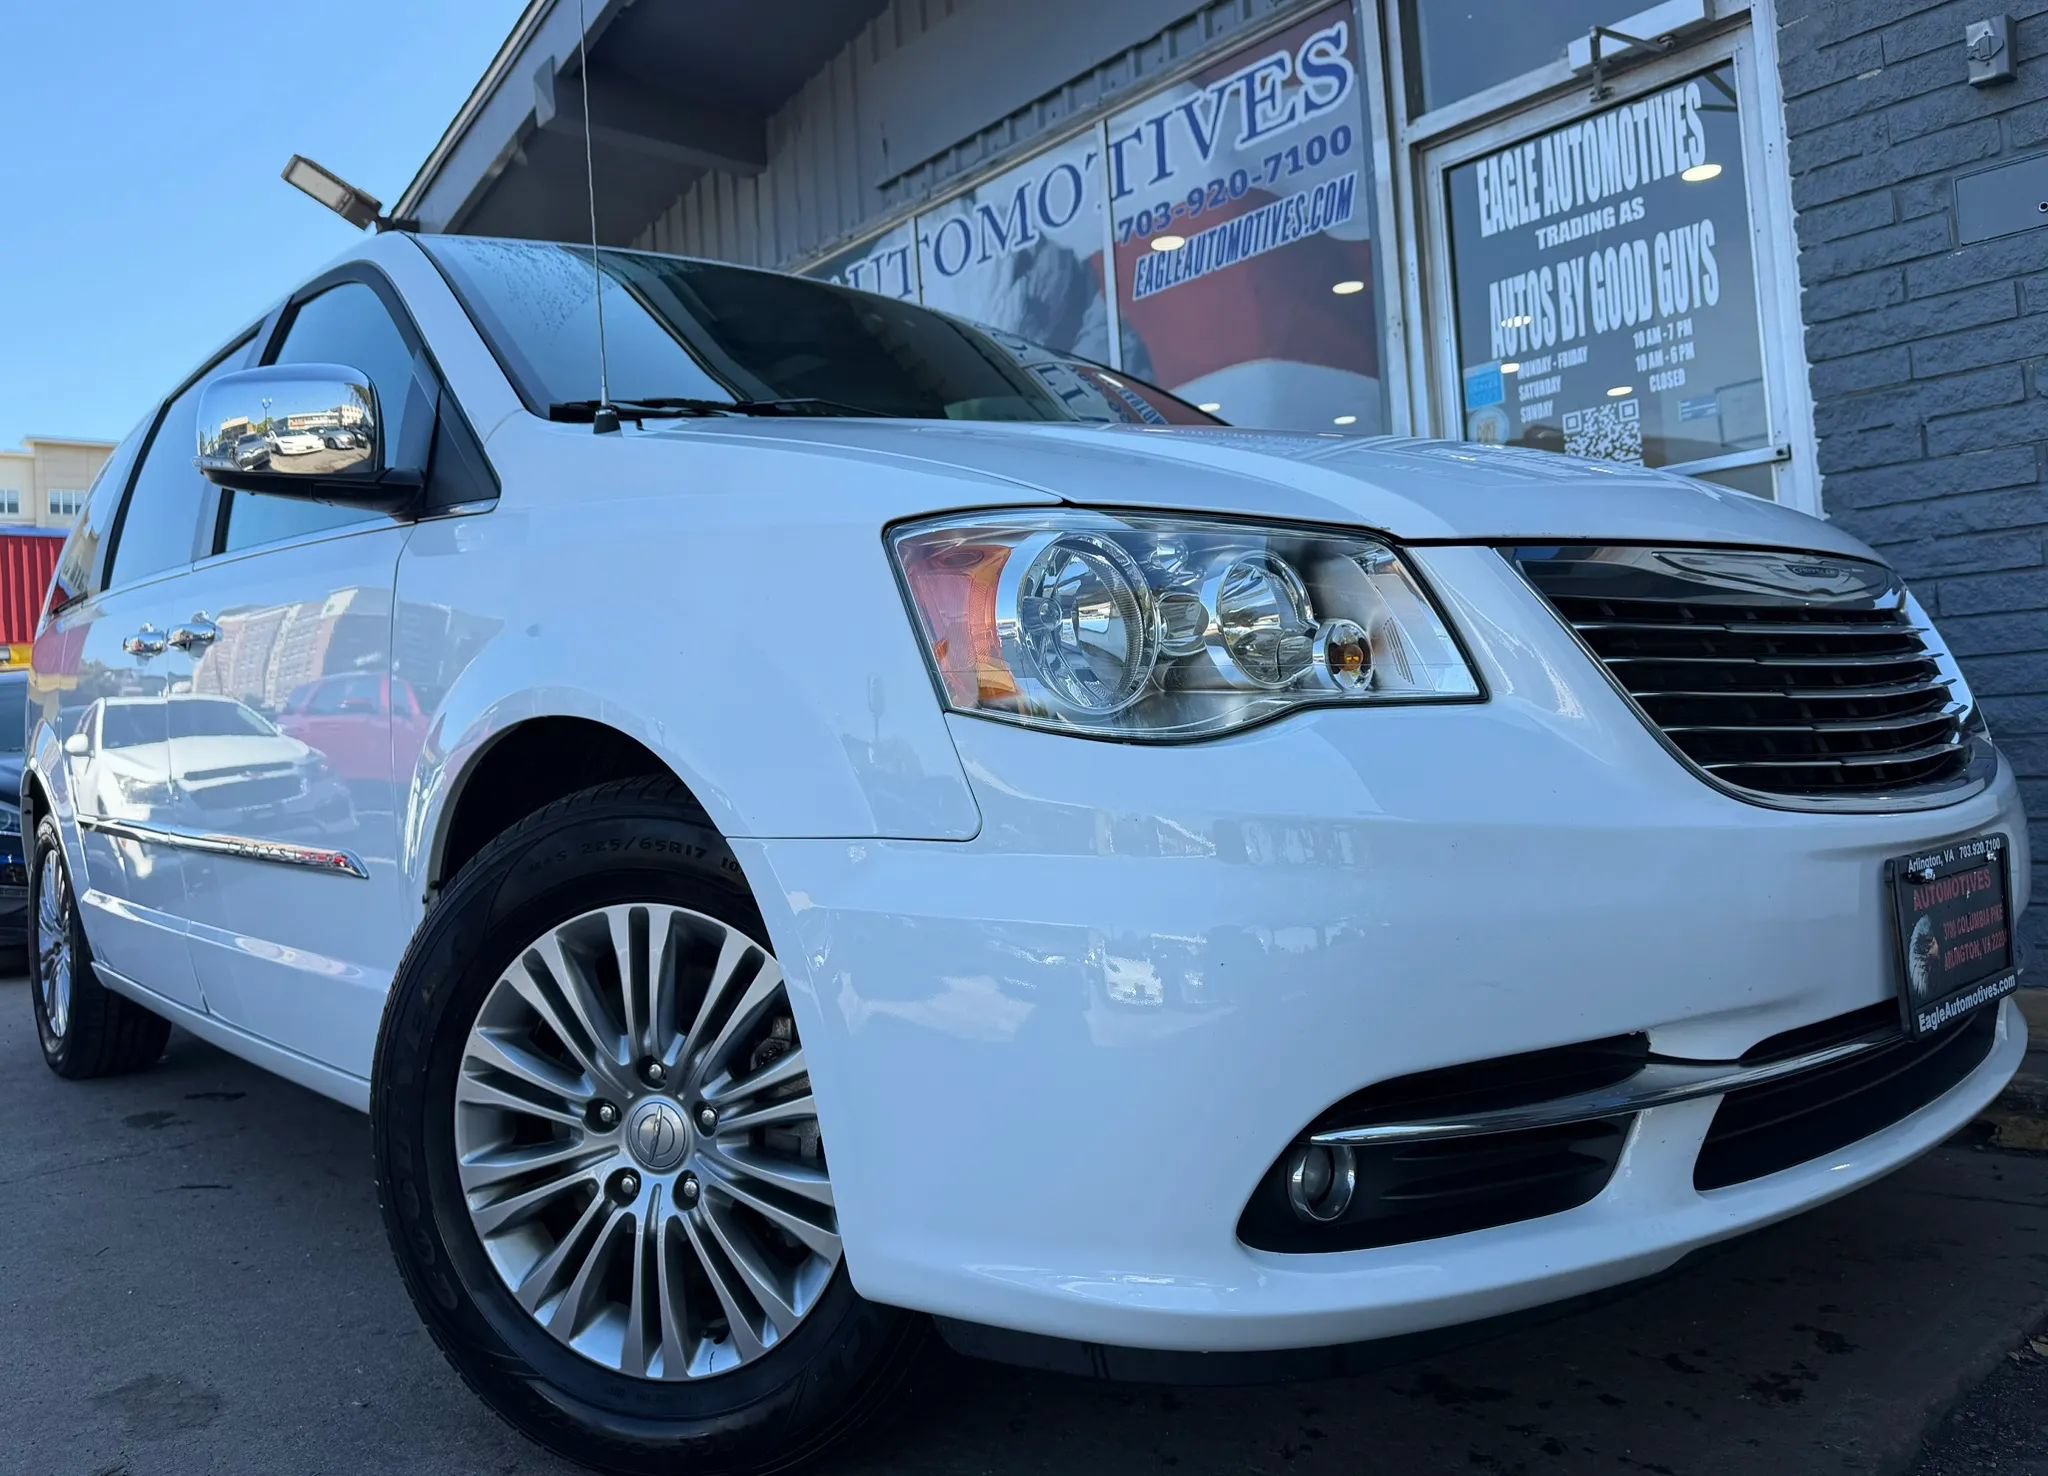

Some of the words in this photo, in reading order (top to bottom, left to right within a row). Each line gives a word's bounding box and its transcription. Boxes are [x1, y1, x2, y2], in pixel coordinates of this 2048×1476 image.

[834, 24, 1350, 299] UTOMOTIVES
[1476, 143, 1541, 238] EAGLE
[1541, 82, 1706, 217] AUTOMOTIVES
[1118, 125, 1352, 245] 703-920-7100
[1134, 172, 1357, 300] EAGLEAUTOMOTIVES.COM
[1535, 206, 1616, 250] TRADING
[1619, 196, 1646, 225] AS
[1489, 266, 1557, 359] AUTOS
[1557, 256, 1586, 342] BY
[1589, 239, 1654, 335] GOOD
[1654, 218, 1720, 317] GUYS
[1632, 330, 1646, 350] 10
[1646, 326, 1662, 347] AM
[1676, 318, 1693, 338] PM
[1557, 345, 1589, 369] FRIDAY
[1635, 353, 1648, 373] 10
[1648, 349, 1664, 370] AM
[1678, 341, 1695, 361] PM
[1518, 374, 1562, 402] SATURDAY
[1649, 367, 1687, 393] CLOSED
[1520, 399, 1554, 424] SUNDAY
[1943, 848, 1955, 864] VA
[1913, 868, 1992, 912] AUTOMOTIVES
[1918, 974, 2017, 1033] EagleAutomotives.com
